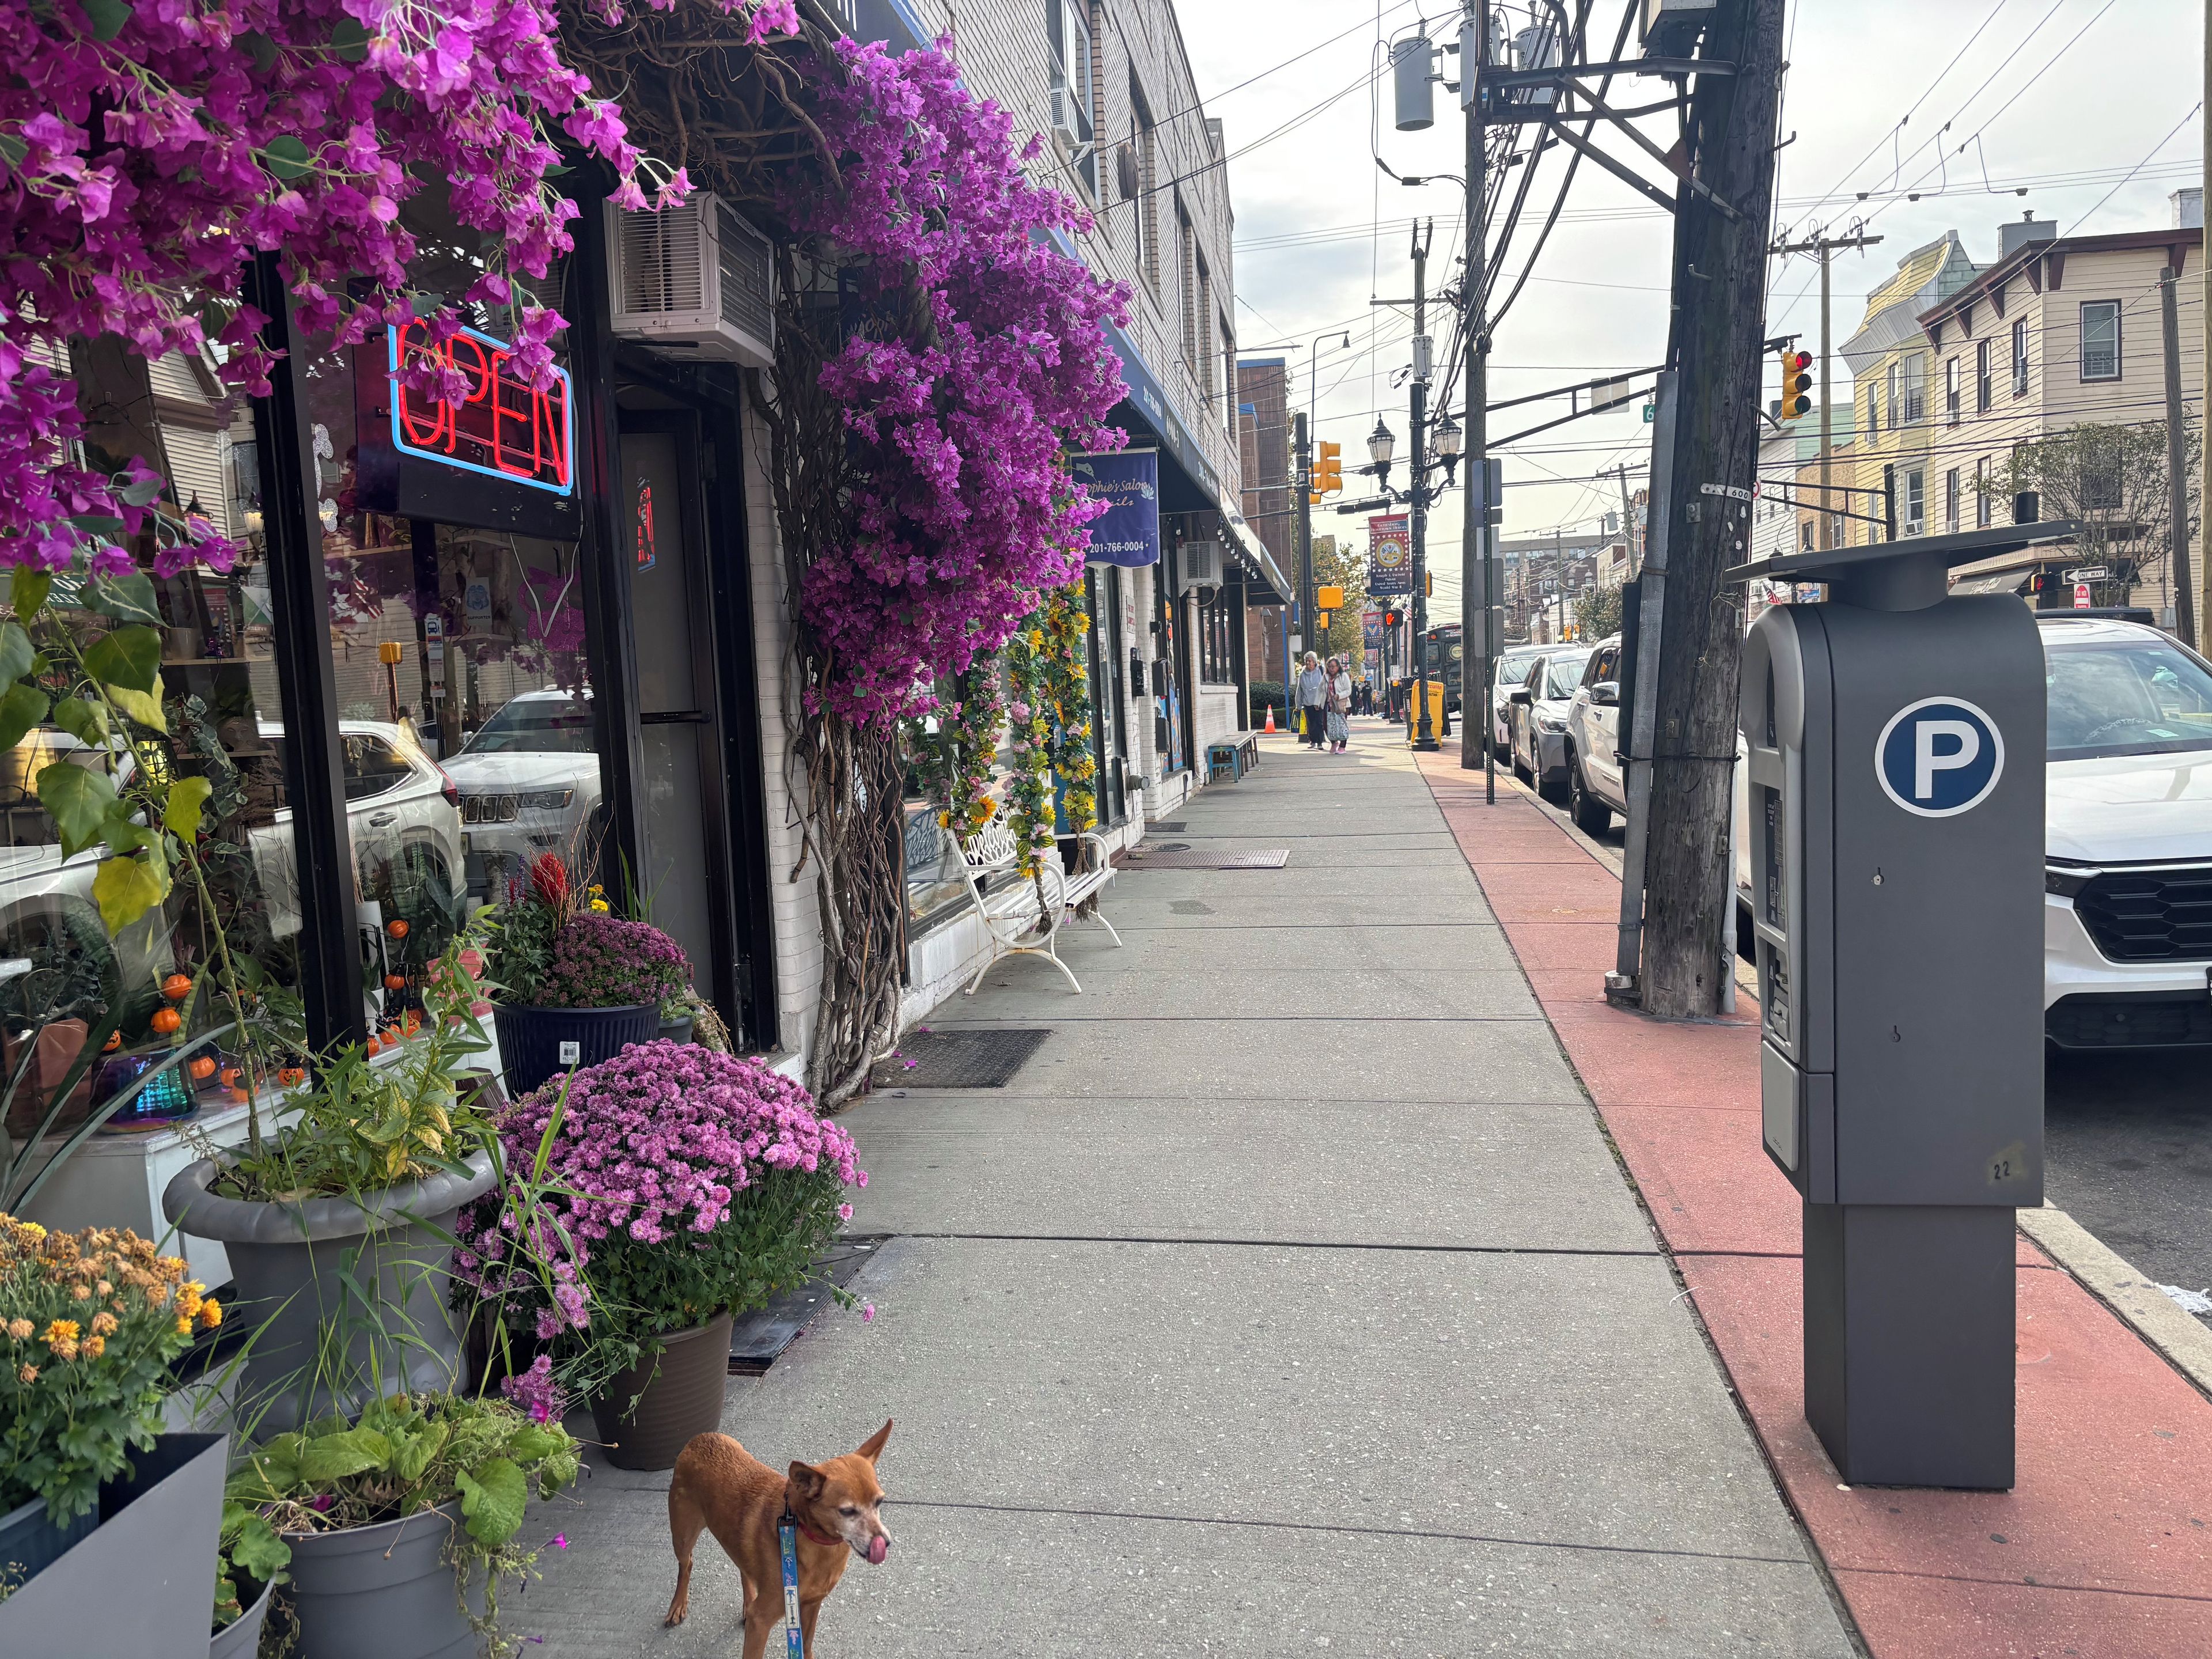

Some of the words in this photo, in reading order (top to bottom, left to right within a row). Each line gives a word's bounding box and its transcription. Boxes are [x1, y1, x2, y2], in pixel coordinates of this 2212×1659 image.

[397, 316, 568, 486] OPEN
[1085, 479, 1120, 497] ophie's
[1732, 489, 1748, 499] 600
[1089, 541, 1144, 554] 201-766-0004
[1915, 720, 1980, 800] P
[1994, 1160, 2010, 1180] 22
